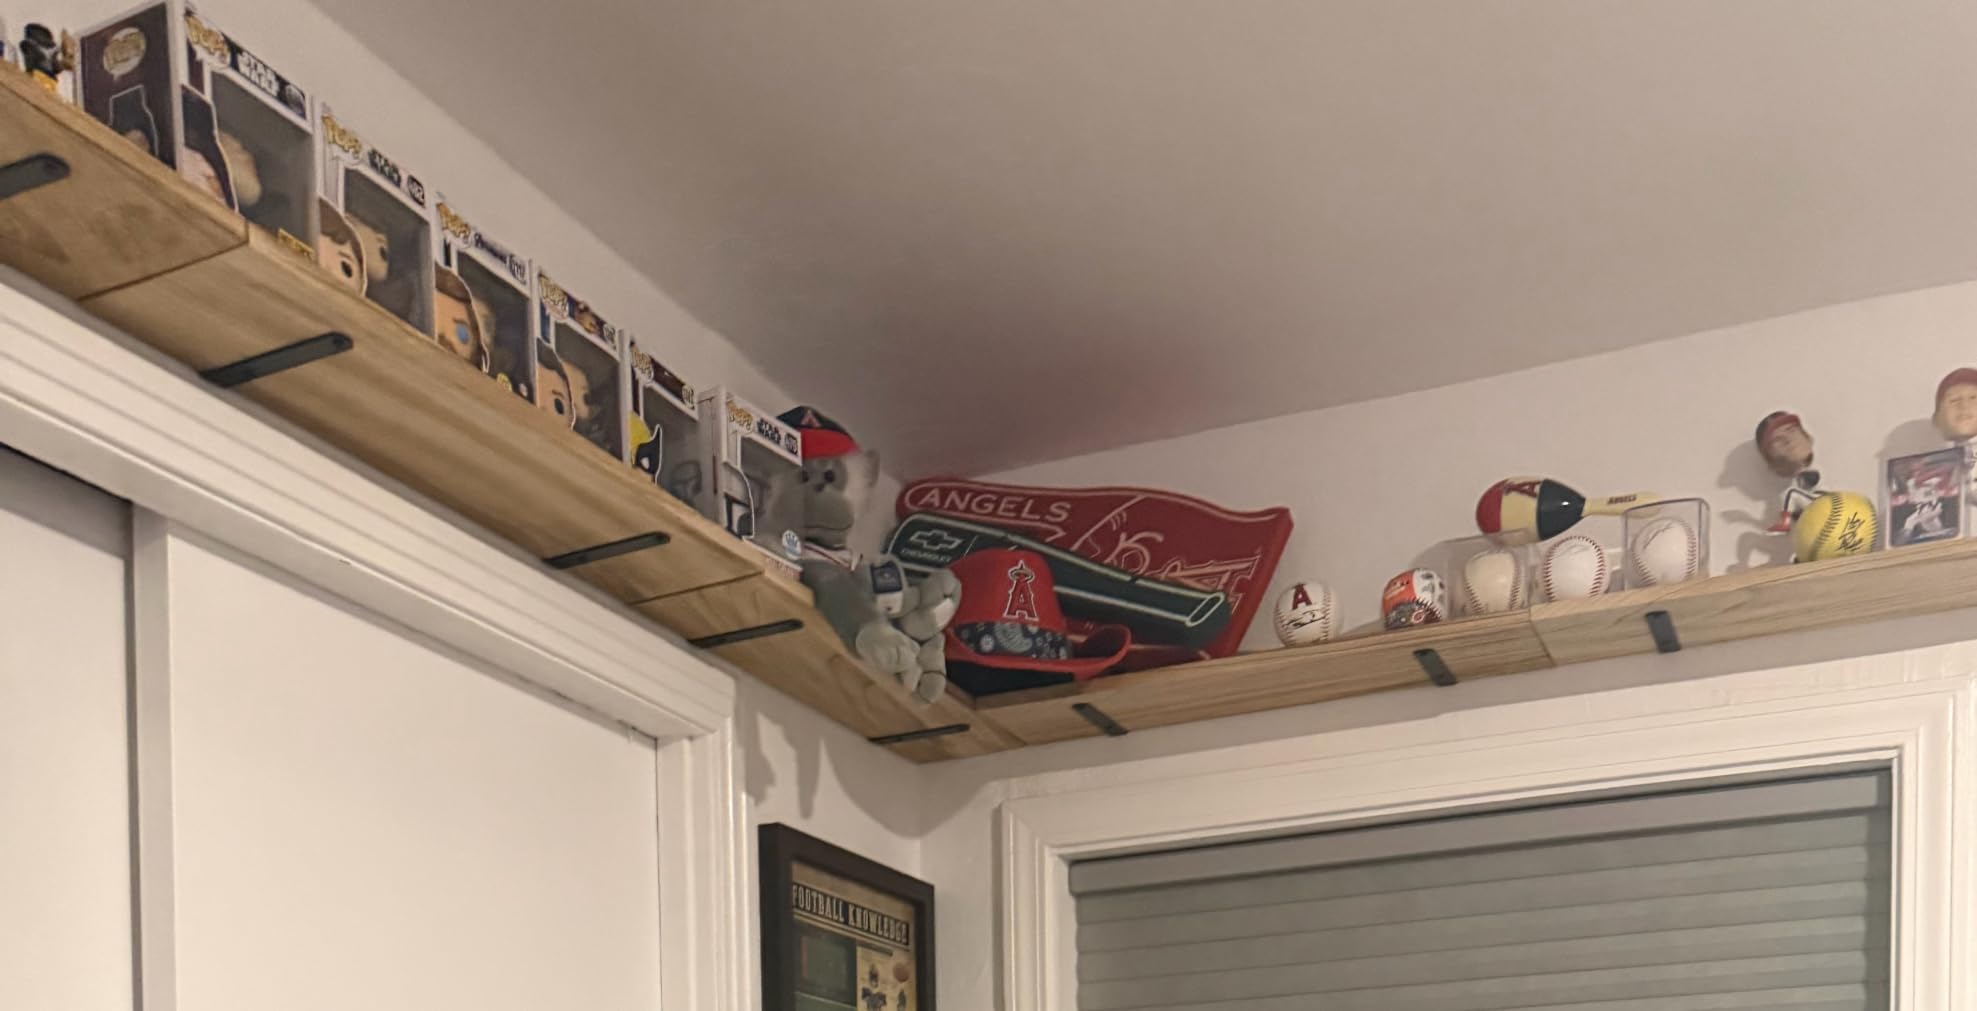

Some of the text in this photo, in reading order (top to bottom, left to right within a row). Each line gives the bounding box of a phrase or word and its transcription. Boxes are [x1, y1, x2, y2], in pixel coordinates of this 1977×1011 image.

[918, 487, 1071, 522] ANGELS
[1003, 560, 1039, 621] A
[1292, 584, 1312, 610] A
[793, 884, 908, 943] FOOTBALL KNOWLEDGE
